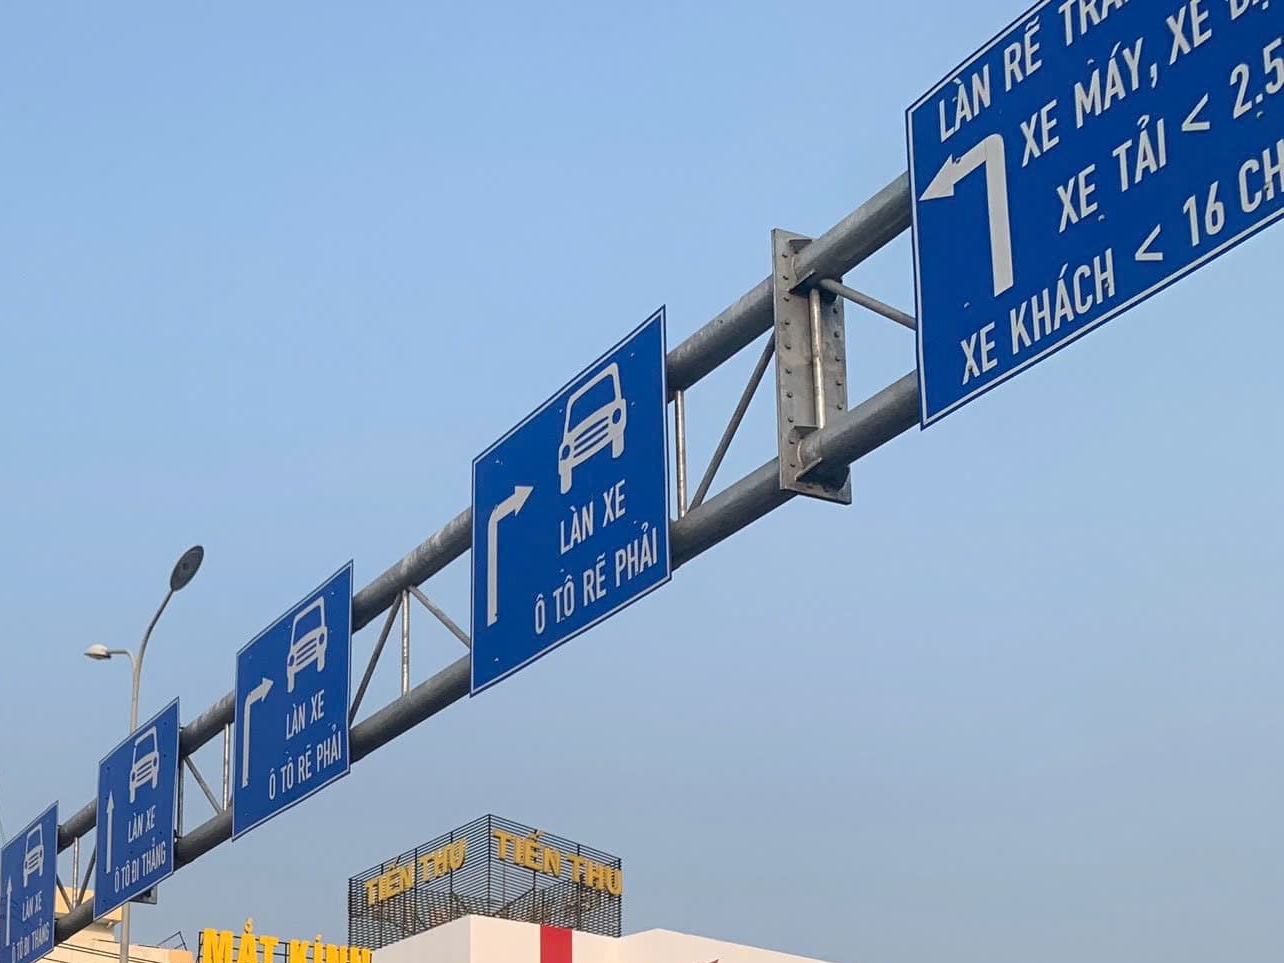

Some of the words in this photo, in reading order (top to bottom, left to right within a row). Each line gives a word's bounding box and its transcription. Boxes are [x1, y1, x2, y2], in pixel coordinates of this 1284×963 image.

[938, 63, 991, 143] LÀN
[1003, 15, 1043, 93] RẼ
[1020, 99, 1060, 168] XE
[1074, 37, 1158, 129] MÁY,
[1166, 0, 1212, 66] XE
[1056, 164, 1098, 234] XE
[1112, 114, 1167, 193] TẢI
[959, 322, 998, 385] XE
[1009, 248, 1116, 356] KHÁCH
[1182, 181, 1226, 248] 16
[559, 501, 594, 556] LÀN
[602, 479, 627, 529] XE
[533, 593, 546, 635] Ô
[552, 571, 575, 624] TÔ
[583, 553, 607, 607] RẼ
[615, 521, 658, 587] PHẢI
[286, 703, 306, 740] LÀN
[310, 688, 325, 723] XE
[268, 768, 276, 801] Ô
[280, 756, 294, 794] TÔ
[297, 743, 312, 782] RẼ
[316, 724, 342, 772] PHẢI
[128, 812, 143, 843] LÀN
[146, 804, 156, 832] XE
[114, 865, 120, 893] Ô
[120, 859, 131, 890] TÔ
[363, 855, 414, 907] TIẾN
[419, 838, 466, 883] THU
[492, 829, 562, 878] TIẾN
[567, 854, 623, 897] THU
